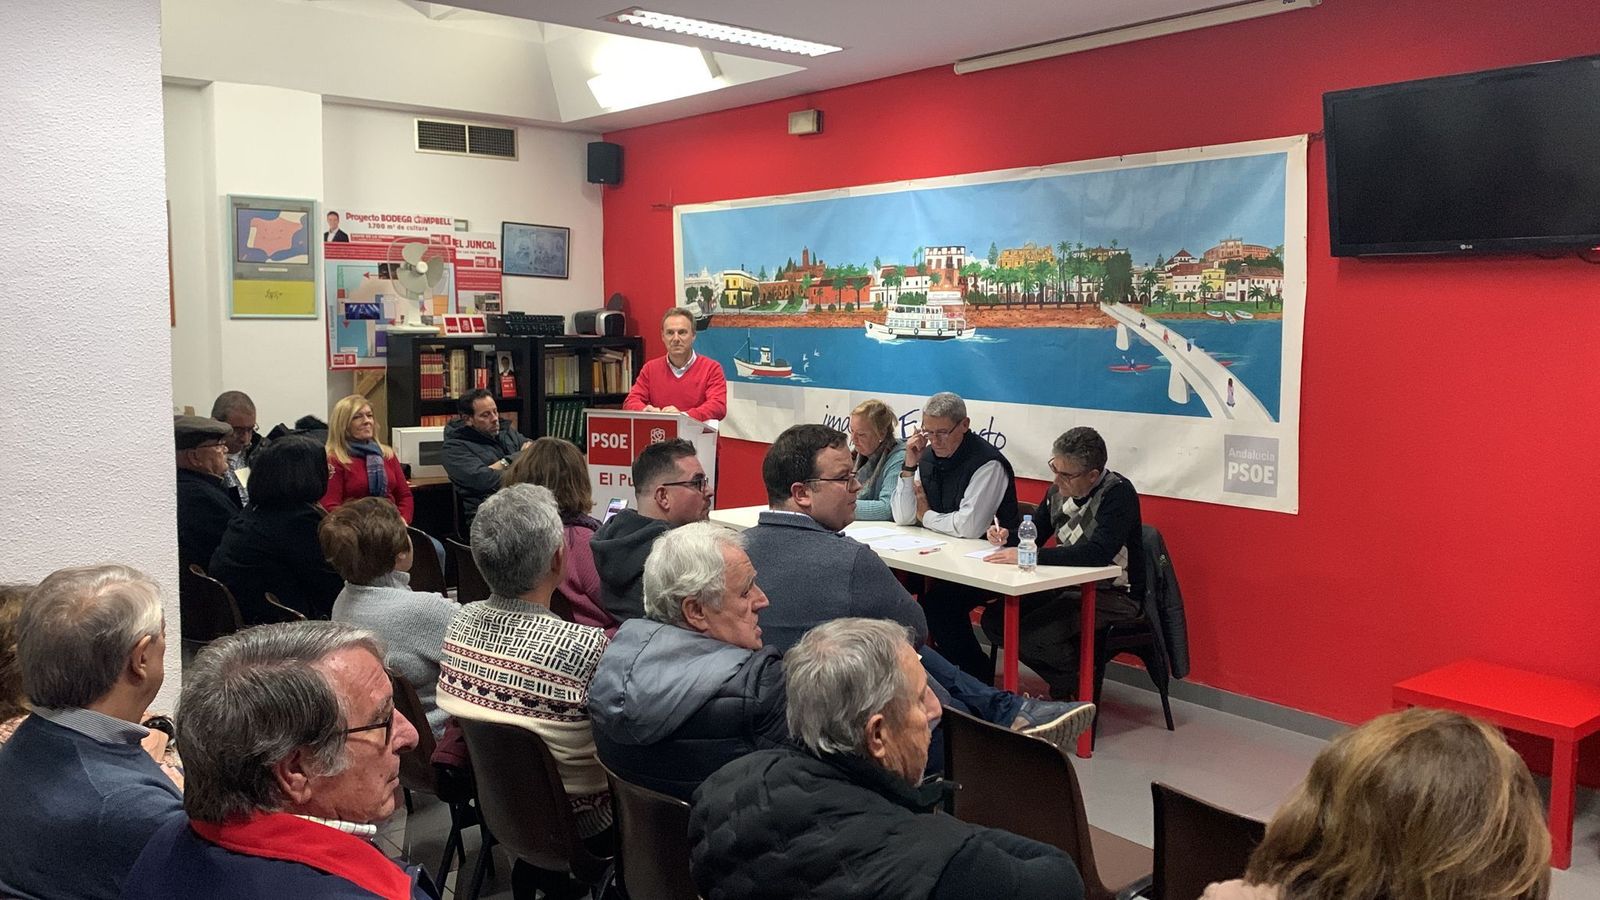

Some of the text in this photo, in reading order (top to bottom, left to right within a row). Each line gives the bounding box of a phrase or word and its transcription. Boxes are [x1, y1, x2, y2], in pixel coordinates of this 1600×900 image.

[346, 212, 380, 222] Proyecto
[381, 214, 412, 223] BODEGA
[466, 240, 497, 249] JUNCAL
[591, 432, 628, 449] PSOE
[600, 472, 634, 487] El Pu
[1227, 462, 1275, 484] PSOE
